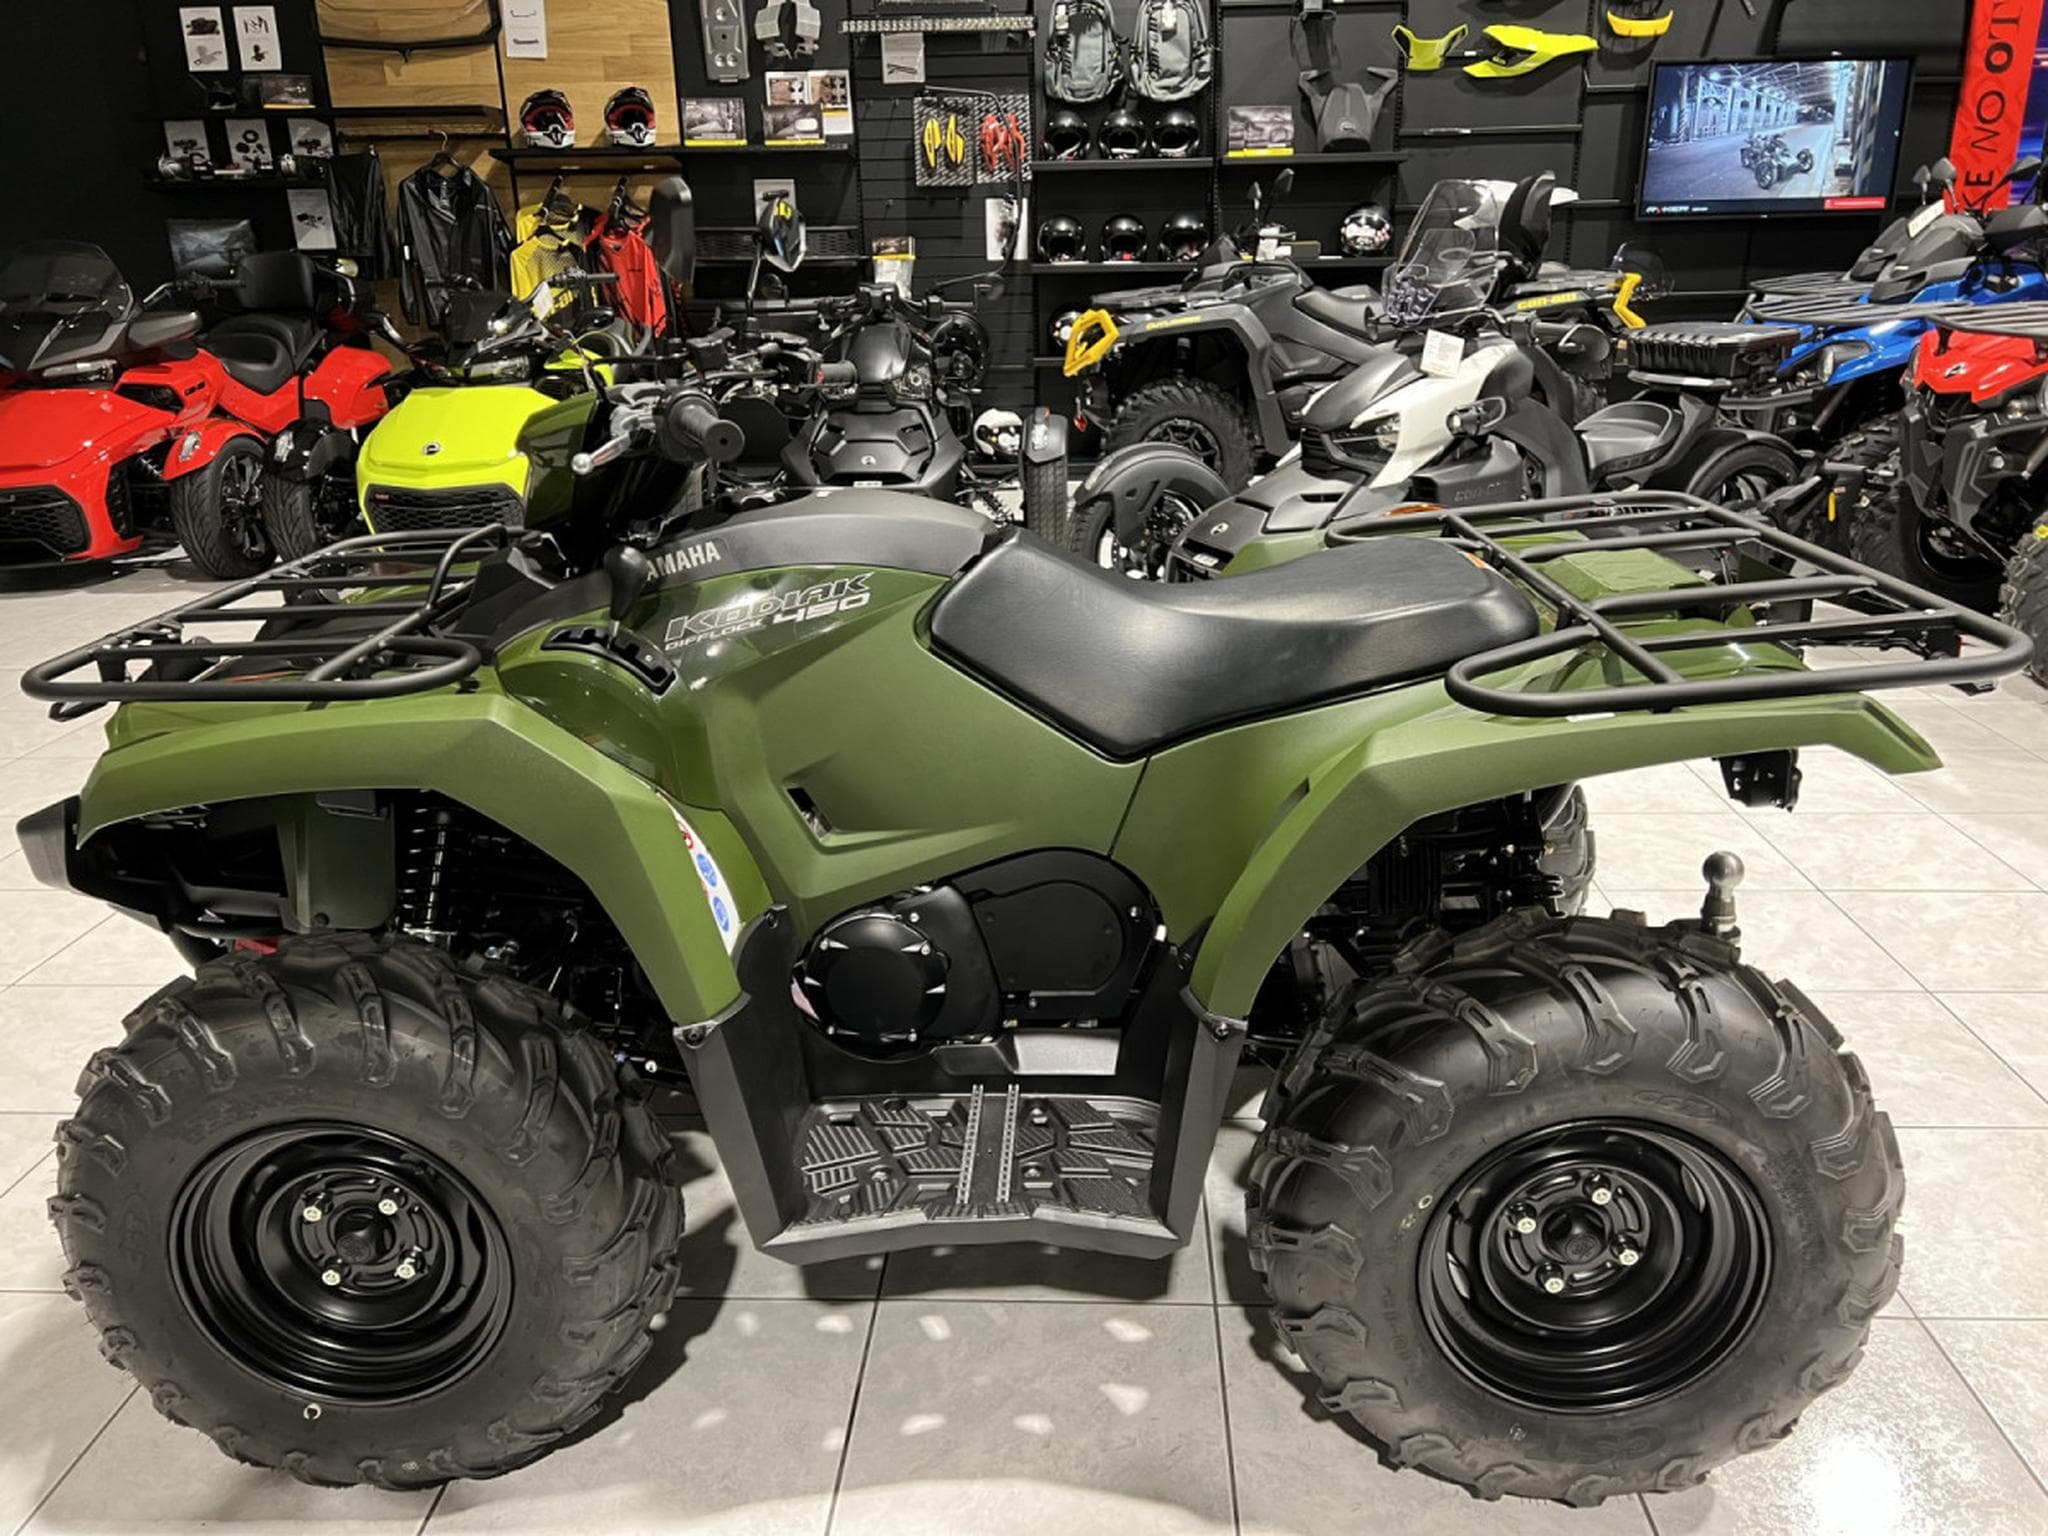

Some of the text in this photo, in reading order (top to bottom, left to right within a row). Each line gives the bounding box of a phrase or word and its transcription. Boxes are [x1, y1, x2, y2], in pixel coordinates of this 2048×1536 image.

[1970, 90, 2006, 153] NO
[646, 541, 721, 581] AMAHA
[664, 571, 875, 642] KODIAK
[773, 593, 870, 625] 450
